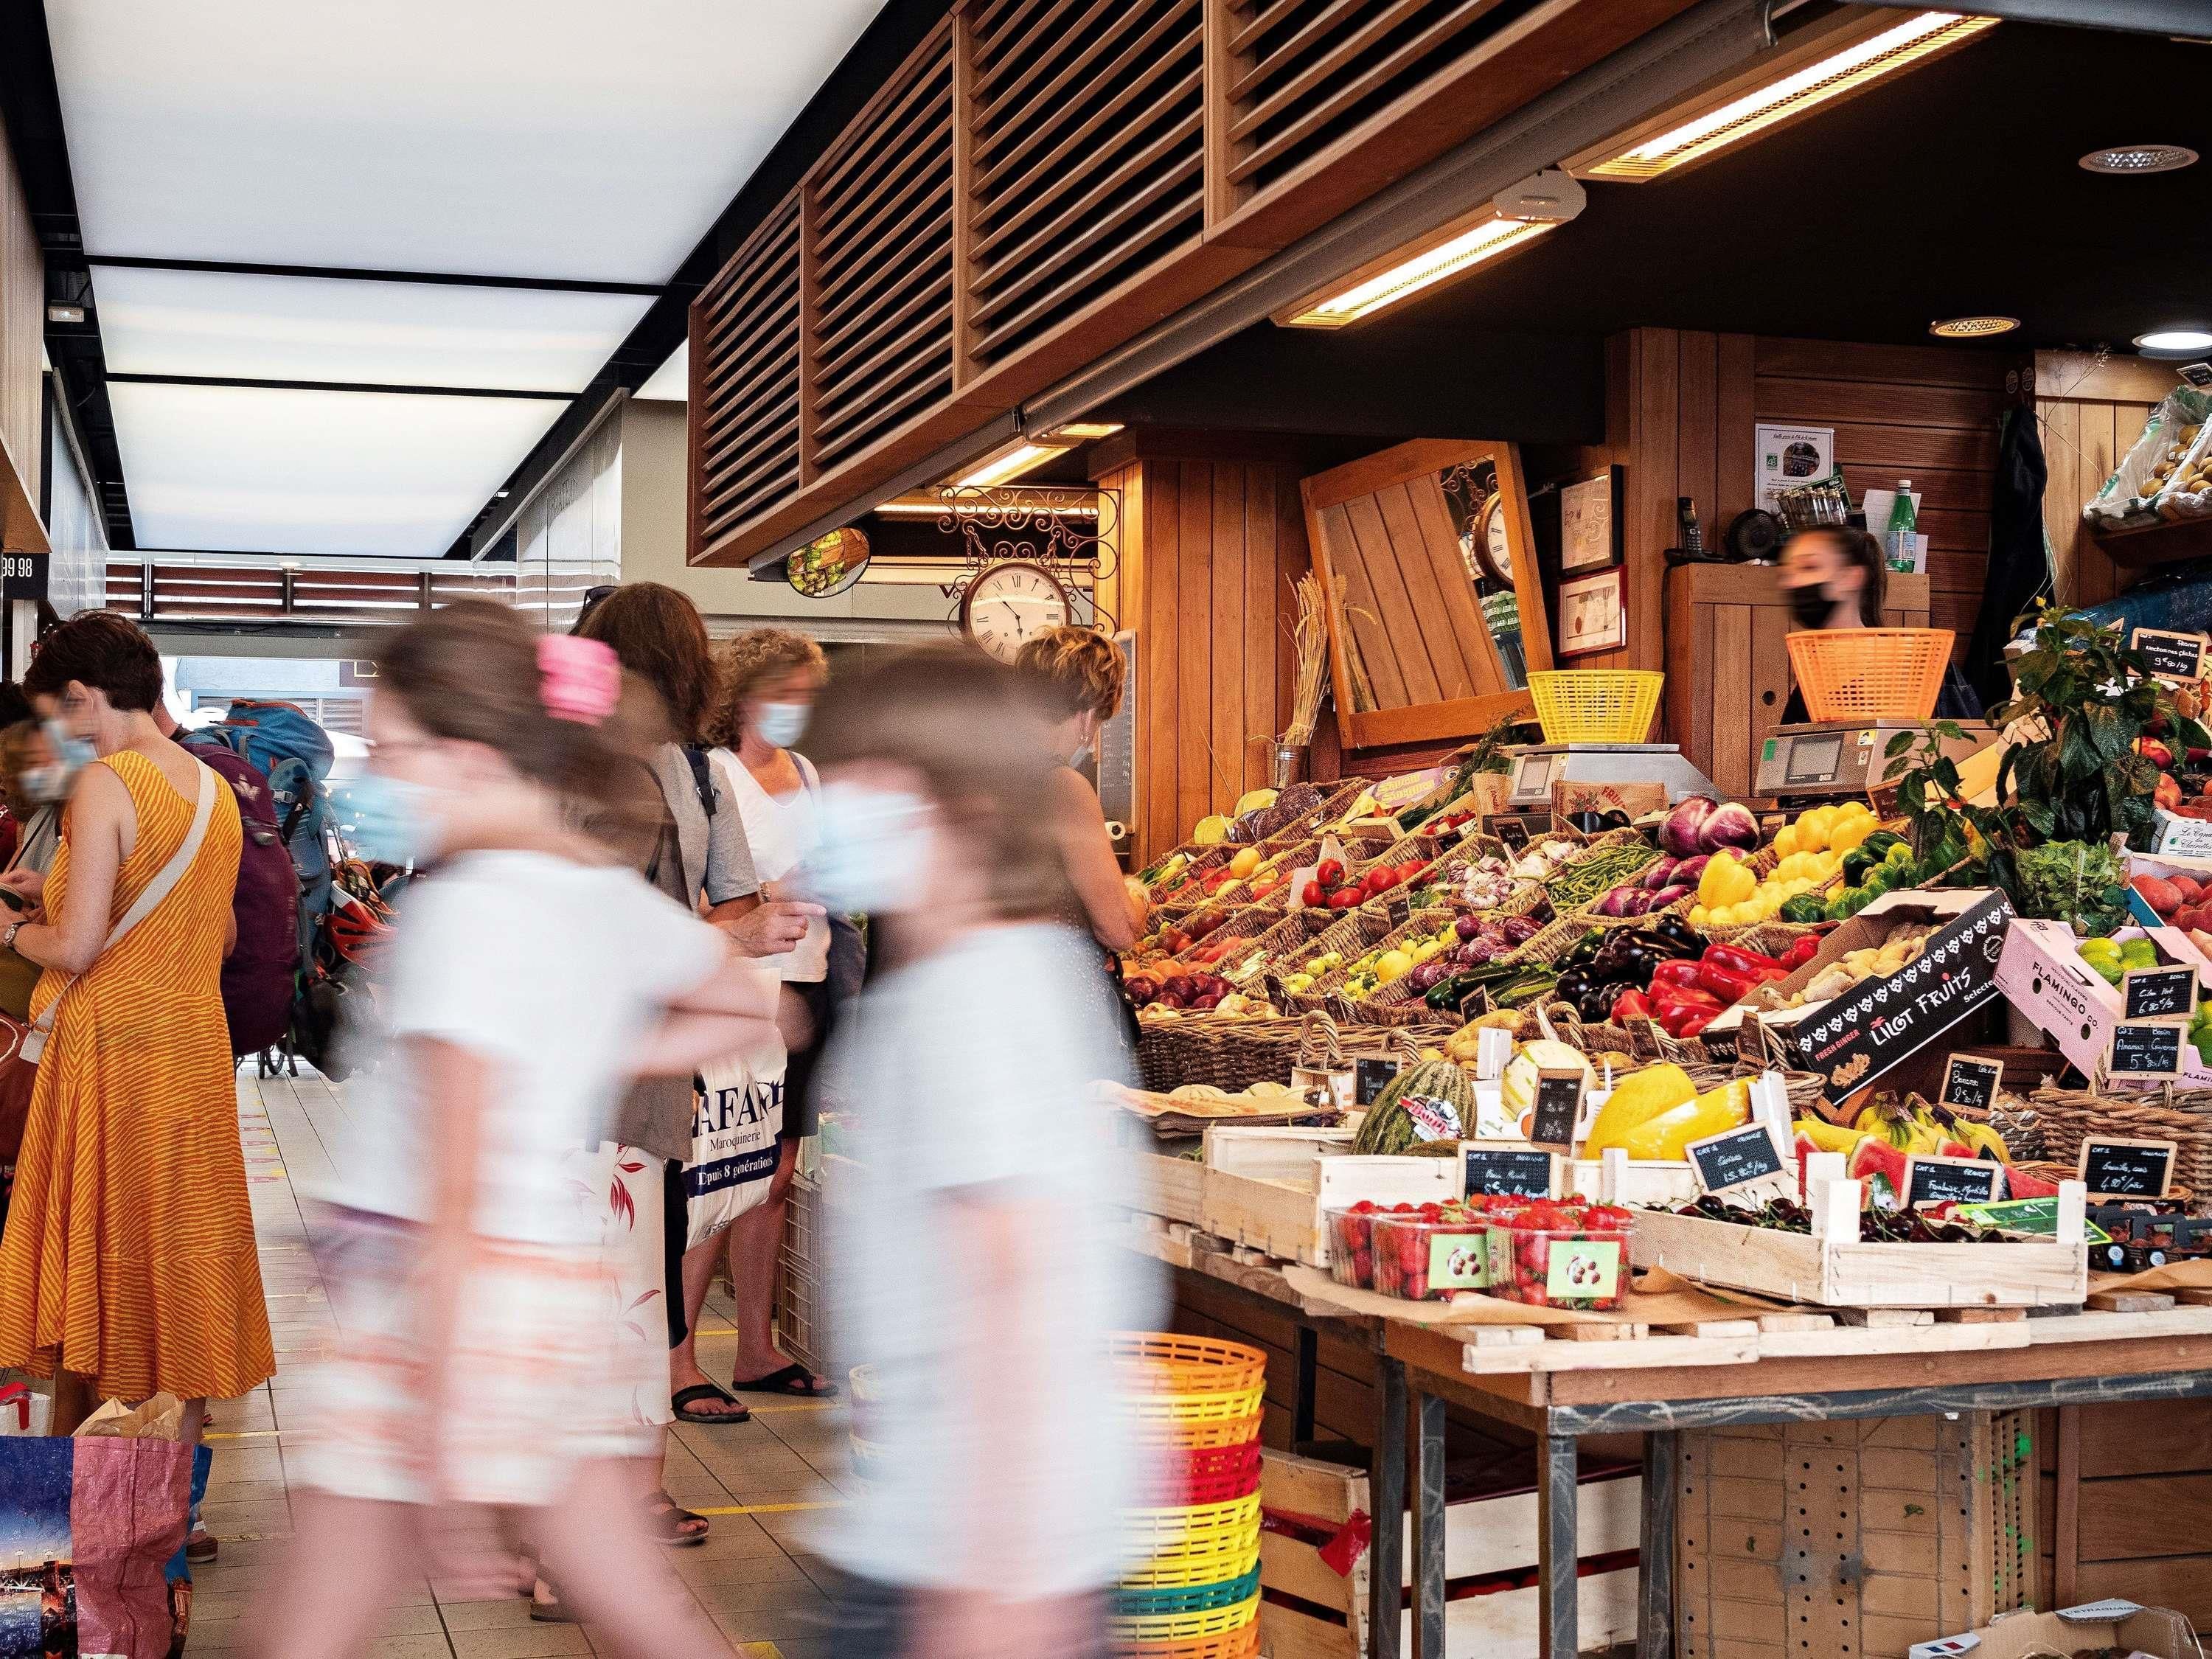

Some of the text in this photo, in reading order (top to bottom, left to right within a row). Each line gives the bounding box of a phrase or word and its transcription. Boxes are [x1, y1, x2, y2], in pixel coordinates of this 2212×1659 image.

[3, 557, 32, 577] 99 98
[1915, 966, 1972, 1015] FRUITS
[2032, 961, 2086, 1015] FLAMINGO
[2087, 1015, 2099, 1029] CO.
[1815, 1029, 1861, 1062] FRESH GINGER
[2183, 1071, 2212, 1083] FLAMI
[709, 1130, 762, 1152] Maroquinerie
[724, 1164, 731, 1178] 8
